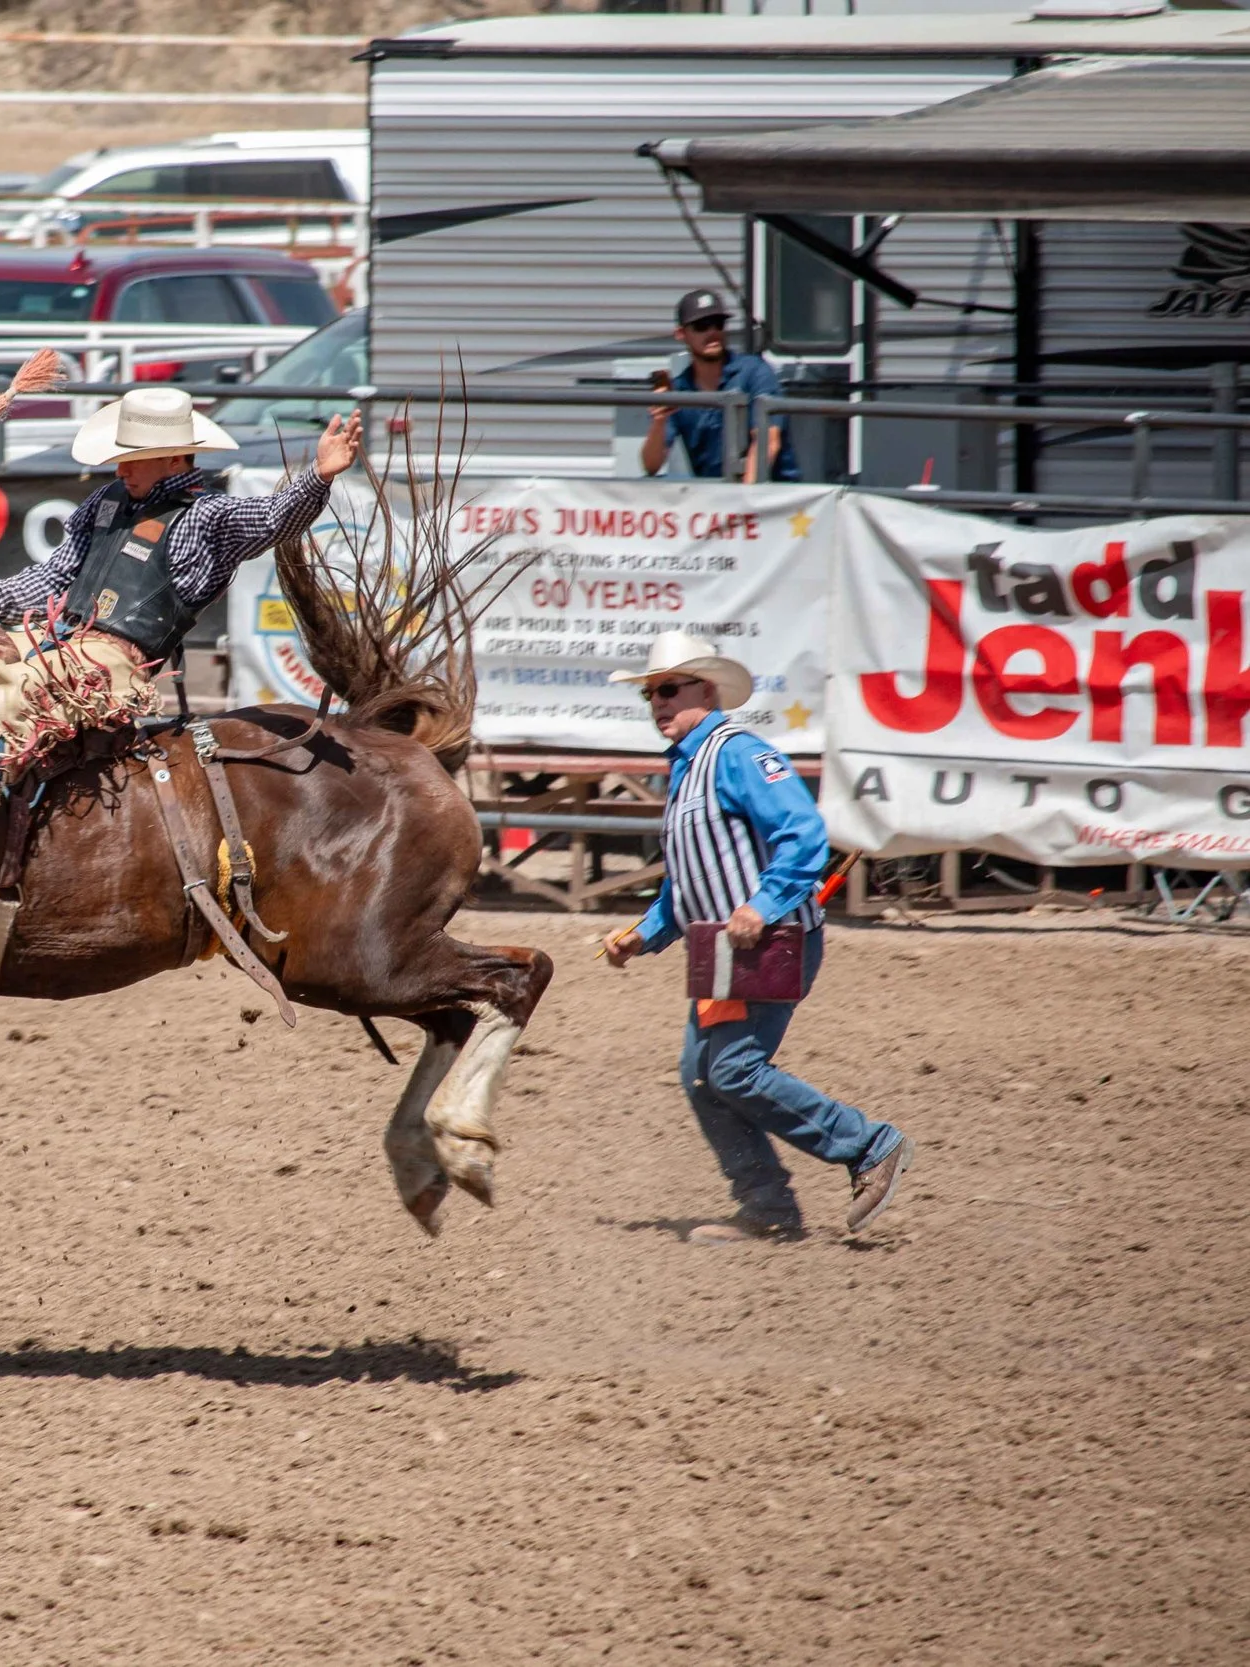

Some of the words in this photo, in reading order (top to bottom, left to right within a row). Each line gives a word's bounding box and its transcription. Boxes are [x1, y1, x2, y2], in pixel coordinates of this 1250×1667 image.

[553, 508, 679, 540] JUMBOS
[688, 512, 760, 540] CAFE
[618, 554, 702, 572] POCATELLO
[706, 556, 737, 572] FOR
[532, 577, 570, 609] 60
[578, 580, 684, 611] YEARS
[967, 540, 1197, 620] tadd
[484, 616, 512, 632] ARE
[516, 616, 570, 634] PROUD
[574, 618, 595, 634] TO
[599, 619, 618, 634] BE
[486, 638, 564, 656] OPERATED
[568, 640, 598, 657] FOR
[570, 703, 650, 722] POCATELL
[853, 766, 1124, 814] AUTO
[1073, 823, 1170, 850] WHERE
[1169, 832, 1250, 853] SMALL
